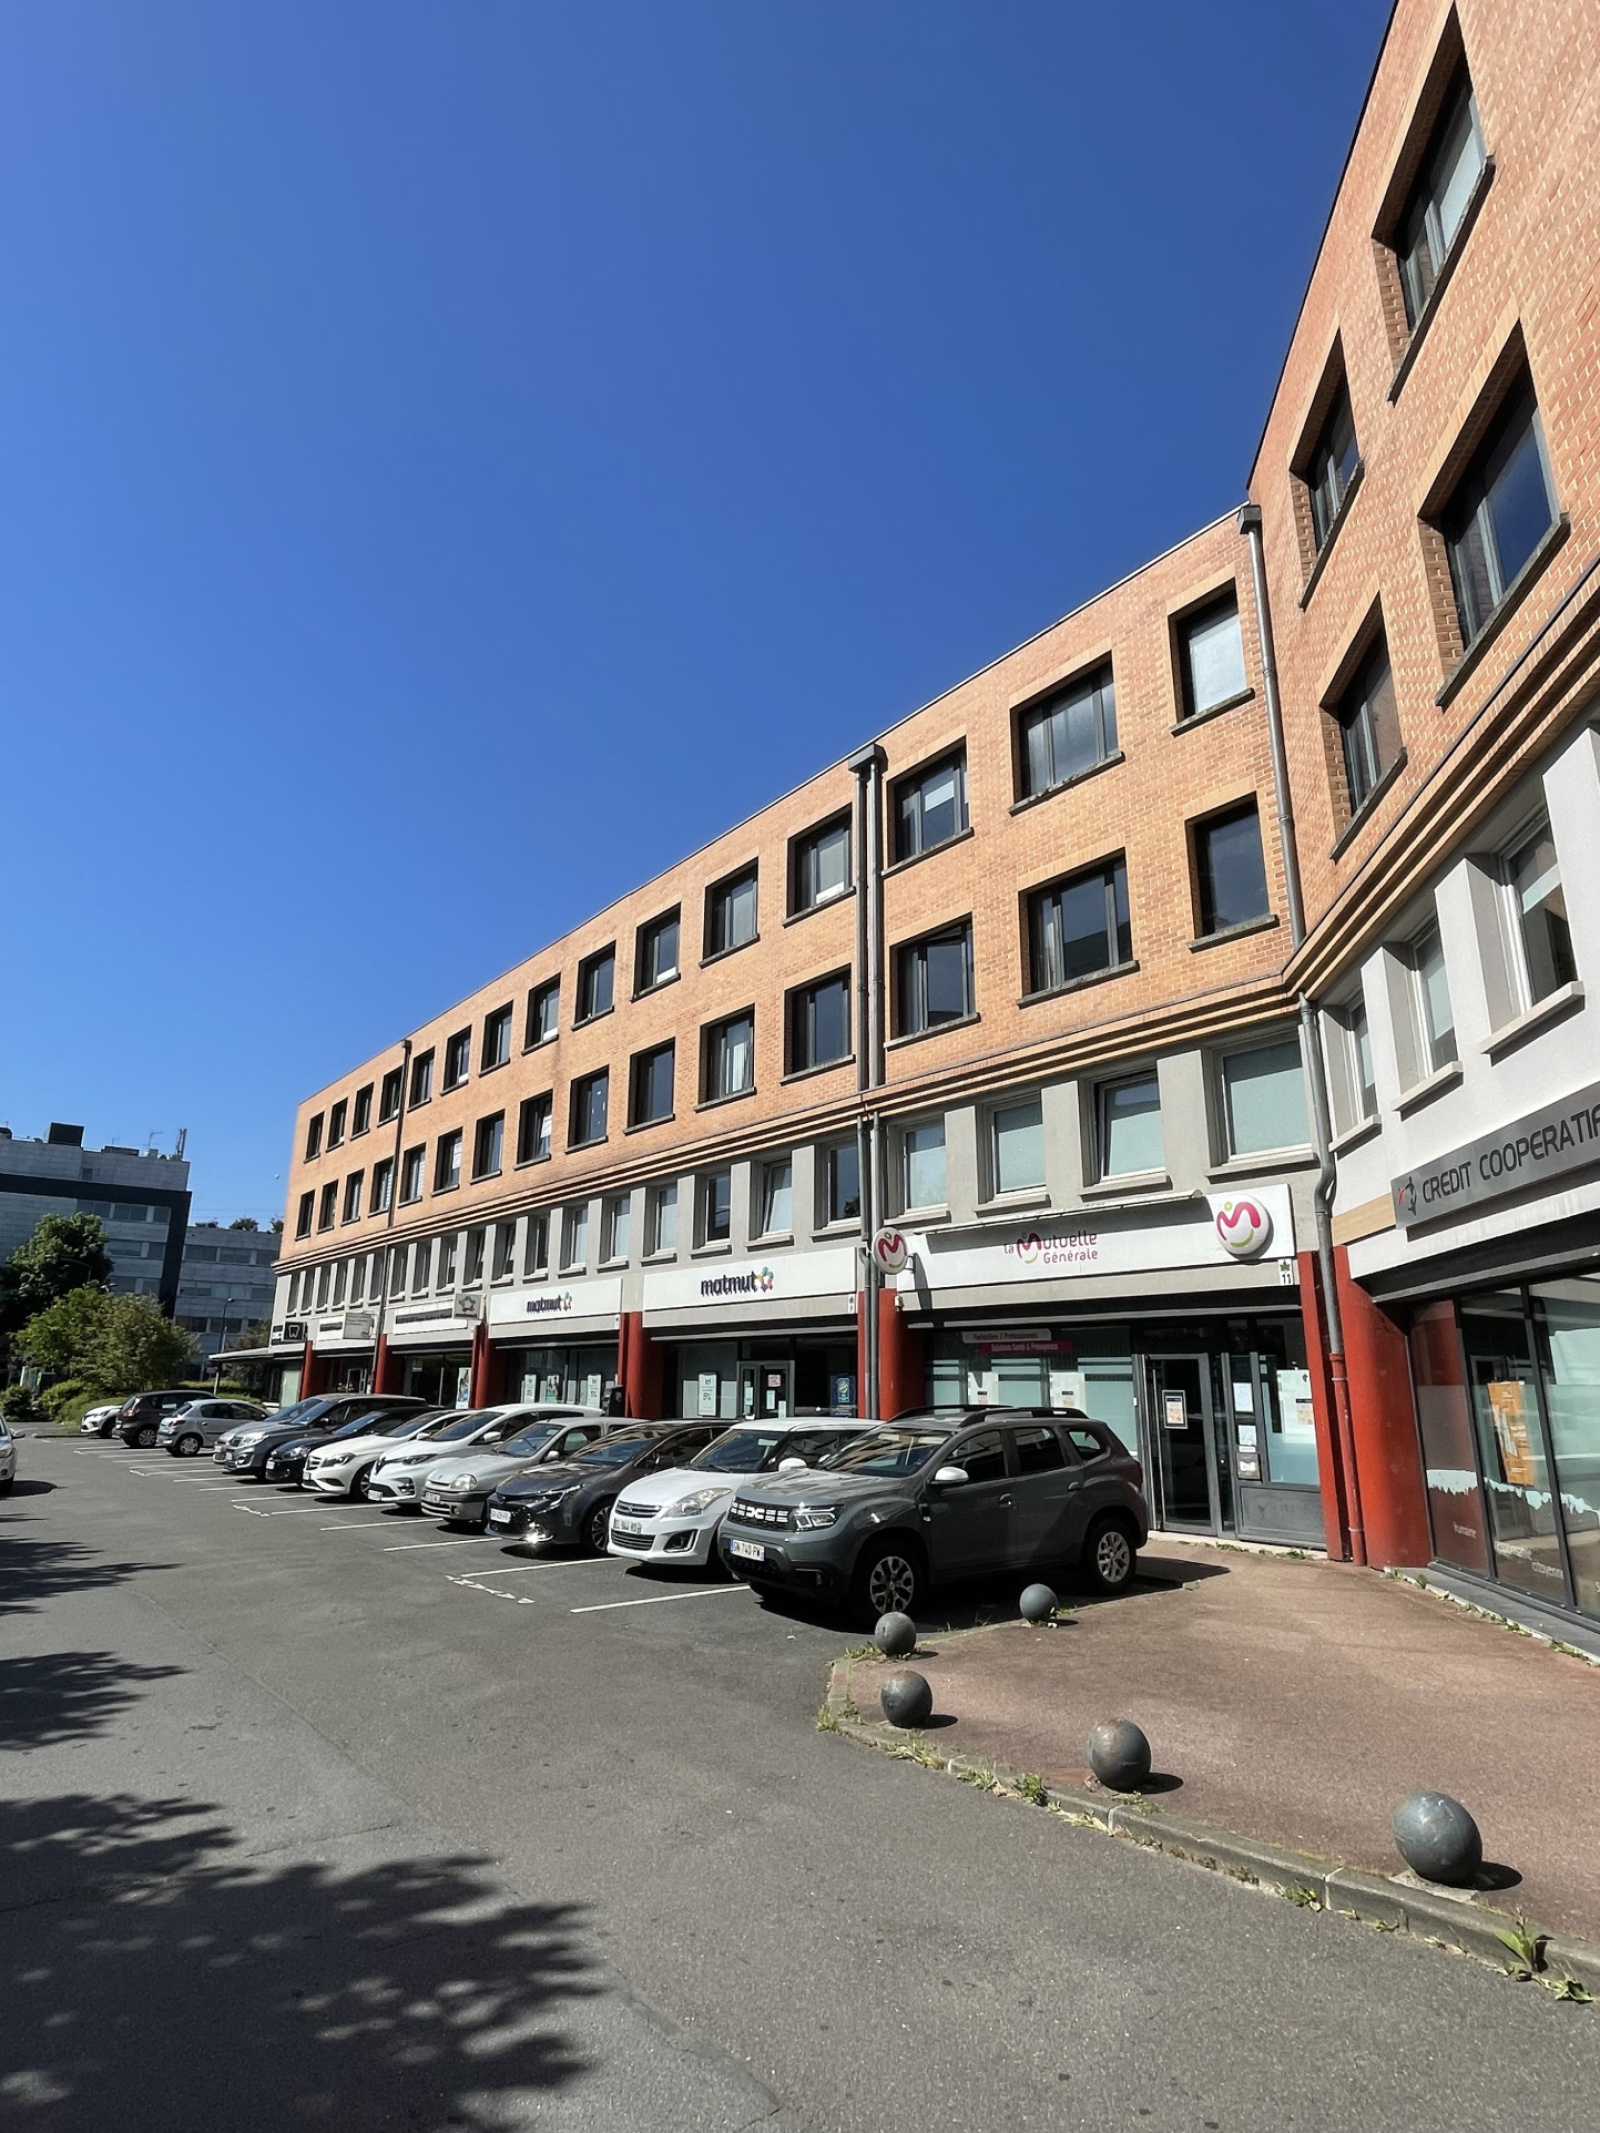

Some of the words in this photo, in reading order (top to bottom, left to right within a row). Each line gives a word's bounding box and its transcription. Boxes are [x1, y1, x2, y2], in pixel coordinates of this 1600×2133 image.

[1422, 1161, 1472, 1204] CREDIT
[1004, 1244, 1015, 1254] la
[1043, 1248, 1099, 1264] Générale
[701, 1270, 758, 1297] matmut
[1282, 1273, 1292, 1285] 11
